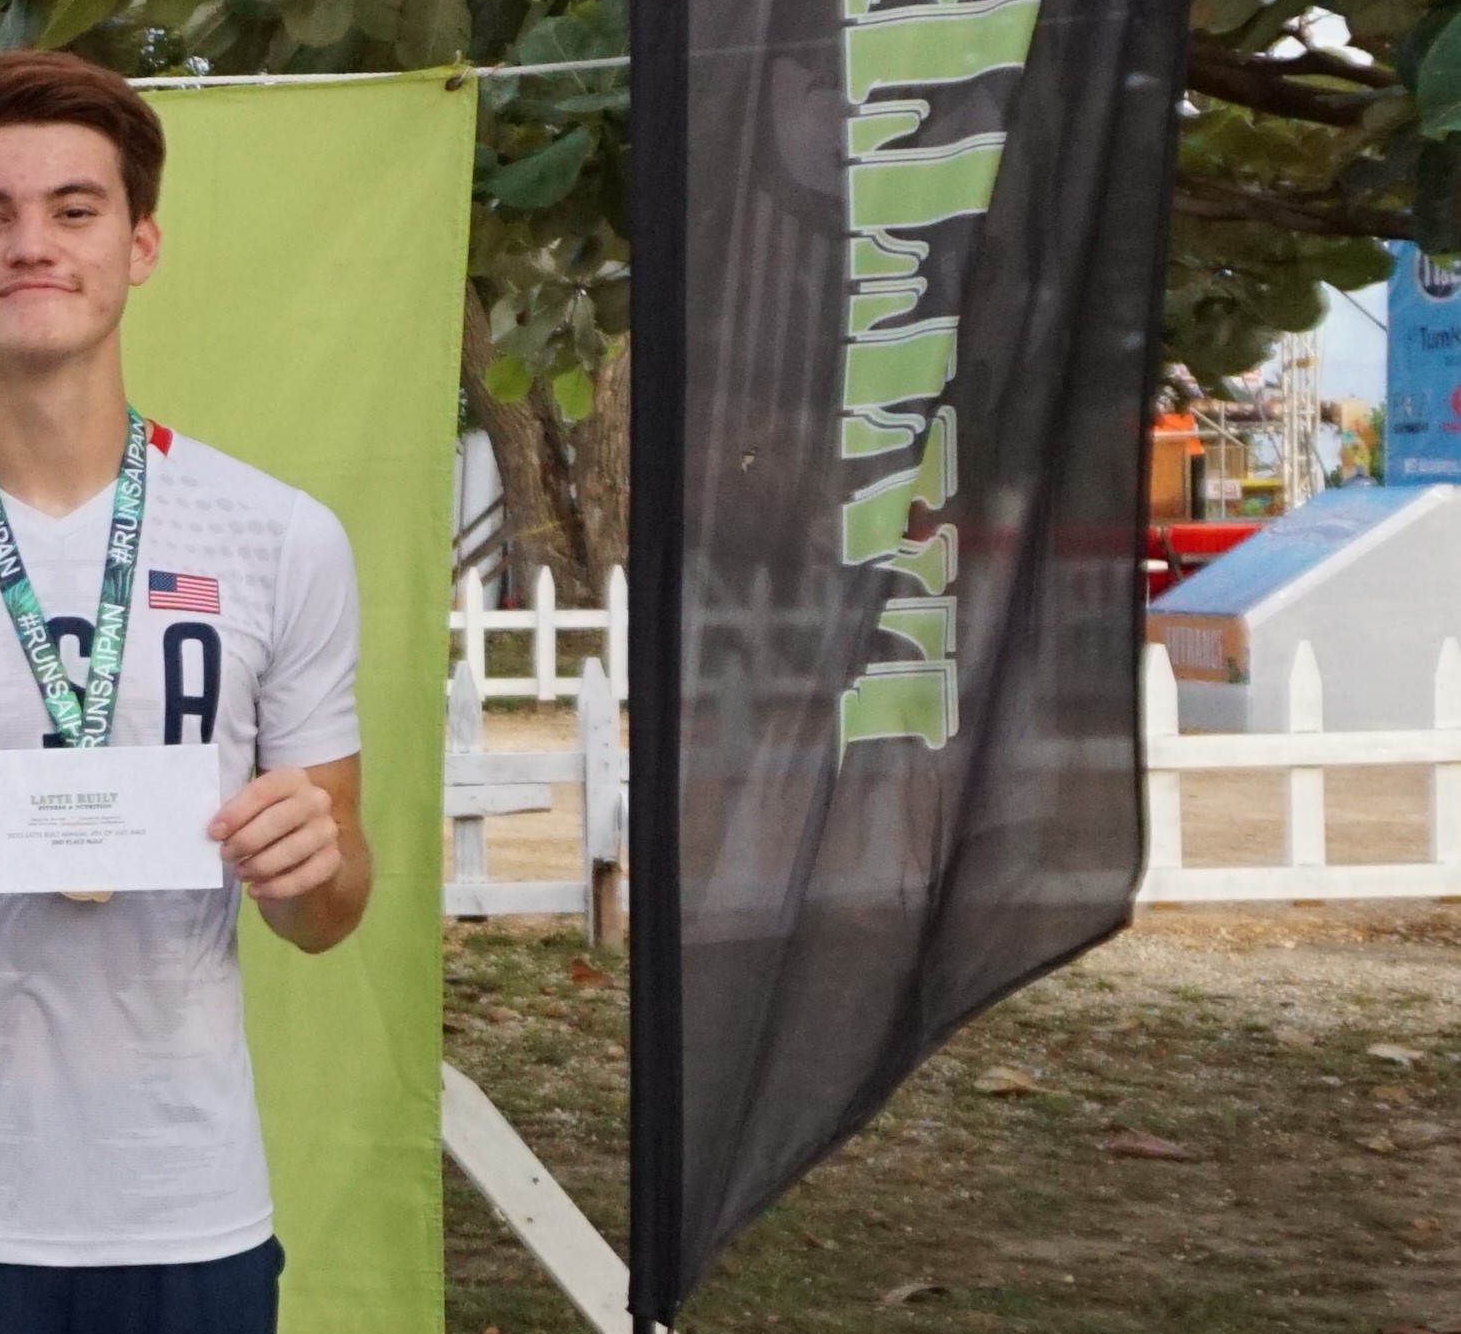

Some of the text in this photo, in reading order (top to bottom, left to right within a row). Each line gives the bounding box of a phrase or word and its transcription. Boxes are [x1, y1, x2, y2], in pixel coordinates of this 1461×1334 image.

[108, 415, 145, 563] #RUNSAIPAN
[30, 793, 118, 805] LATTE BUILT
